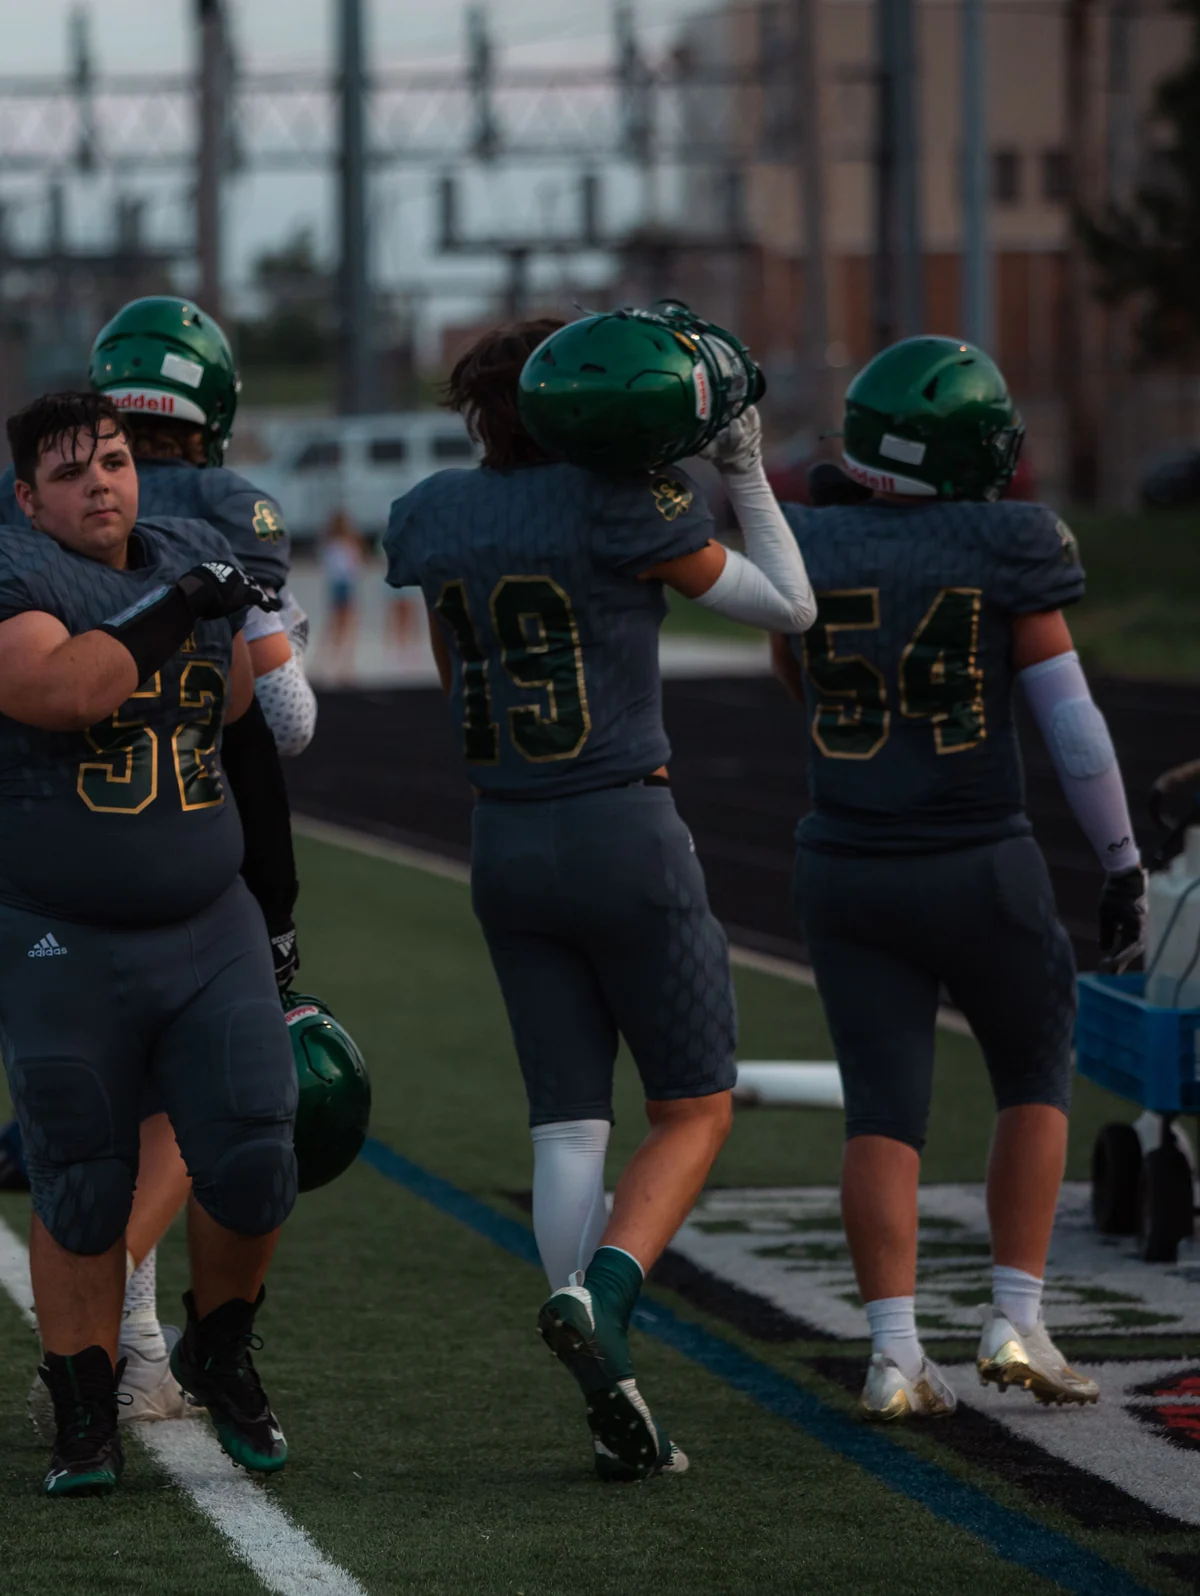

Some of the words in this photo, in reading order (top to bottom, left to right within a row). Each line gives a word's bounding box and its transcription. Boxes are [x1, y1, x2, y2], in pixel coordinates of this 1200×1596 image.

[77, 661, 226, 815] 52
[435, 575, 592, 768] 19
[802, 587, 988, 760] 54
[27, 947, 68, 959] adidas
